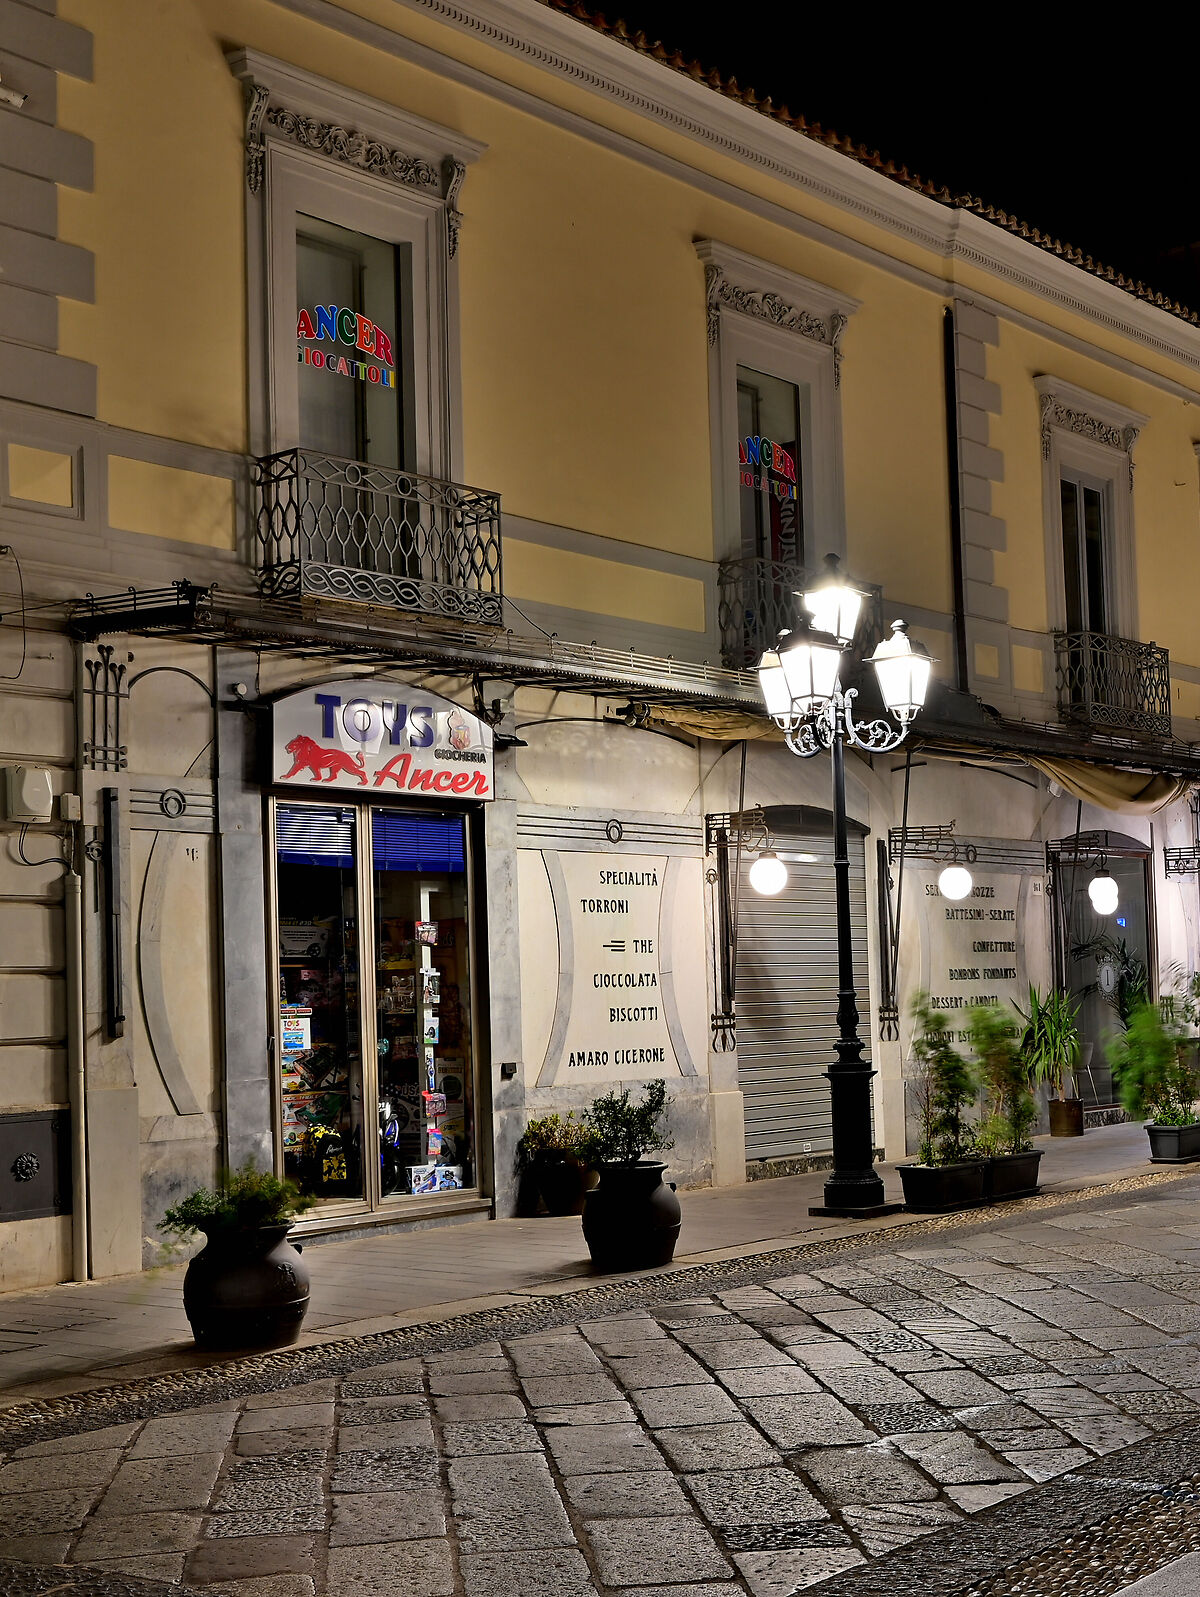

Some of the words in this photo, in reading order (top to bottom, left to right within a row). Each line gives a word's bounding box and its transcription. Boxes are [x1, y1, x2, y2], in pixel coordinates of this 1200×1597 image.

[296, 304, 395, 367] ANCER
[739, 471, 797, 500] IOCATTOLI
[315, 693, 434, 748] TOYS
[434, 747, 487, 764] GIOCHERIA
[373, 753, 489, 796] Ancer
[599, 868, 658, 887] SPECIALITÀ
[581, 899, 629, 914] TORRONI
[632, 939, 654, 954] THE
[972, 941, 1015, 953] CONFETTURE
[593, 973, 657, 989] CIOCCOLATA
[949, 968, 980, 981] BONBONS
[931, 996, 963, 1009] DESSERT
[609, 1007, 658, 1023] BISCOTTI
[568, 1051, 609, 1067] AMARO
[614, 1048, 665, 1065] CICERONE
